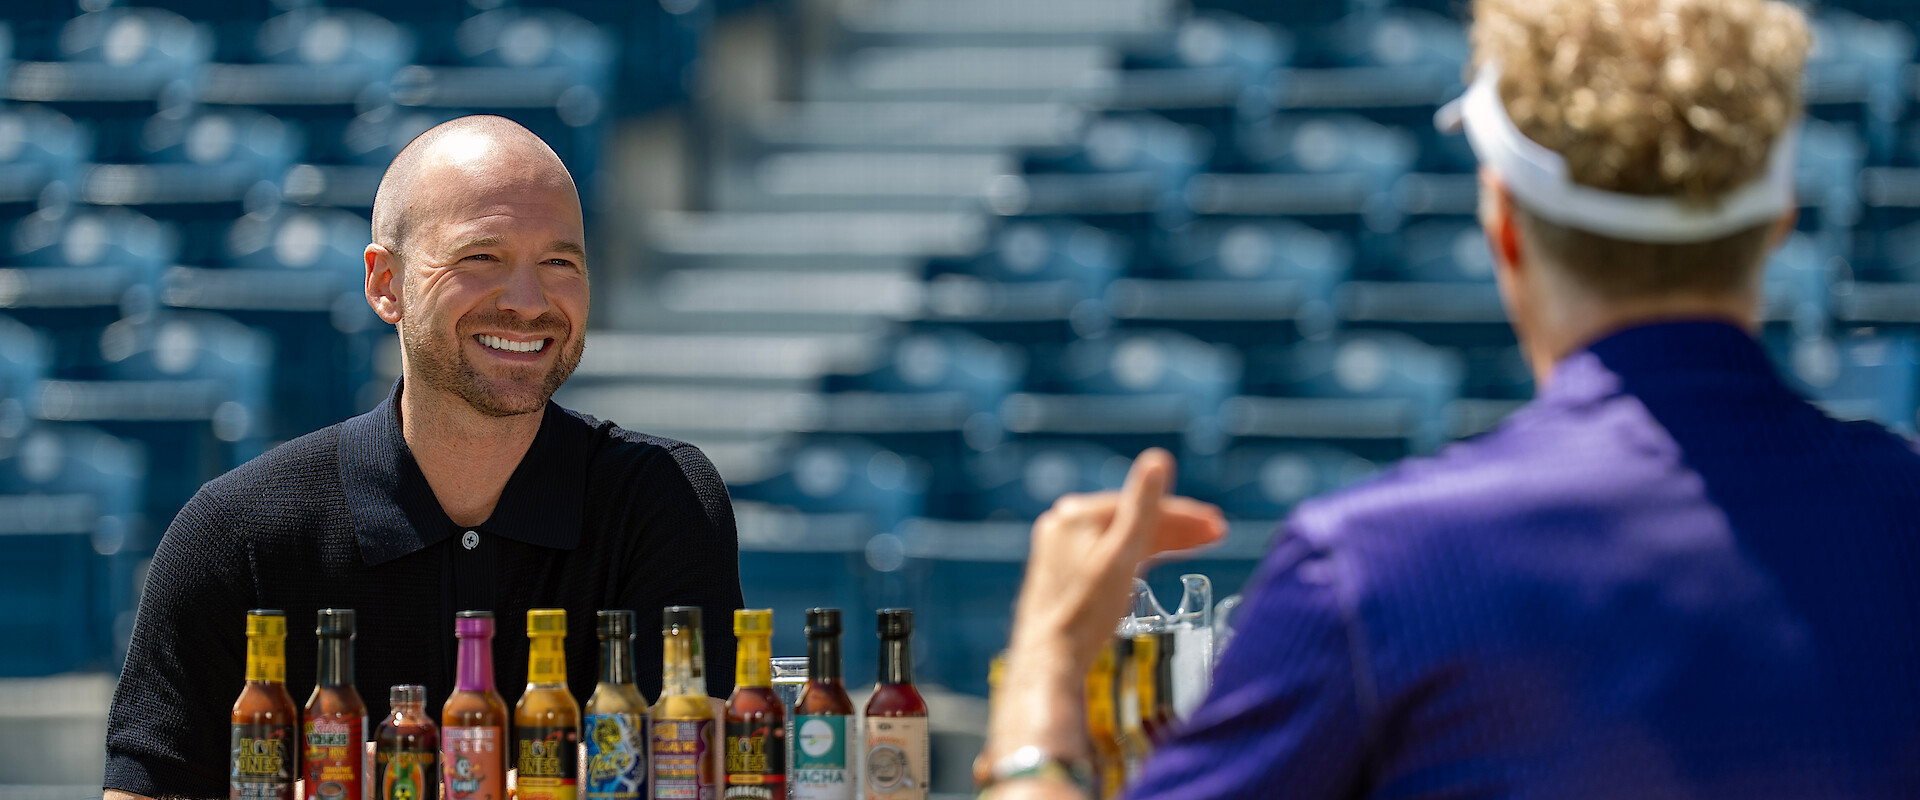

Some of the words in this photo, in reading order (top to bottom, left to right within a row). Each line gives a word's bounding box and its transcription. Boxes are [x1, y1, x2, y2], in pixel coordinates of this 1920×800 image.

[240, 738, 280, 755] HOT
[519, 739, 558, 757] HOT
[727, 736, 764, 754] HOT
[238, 756, 280, 773] ONES
[518, 757, 560, 775] ONES
[726, 754, 766, 772] ONES
